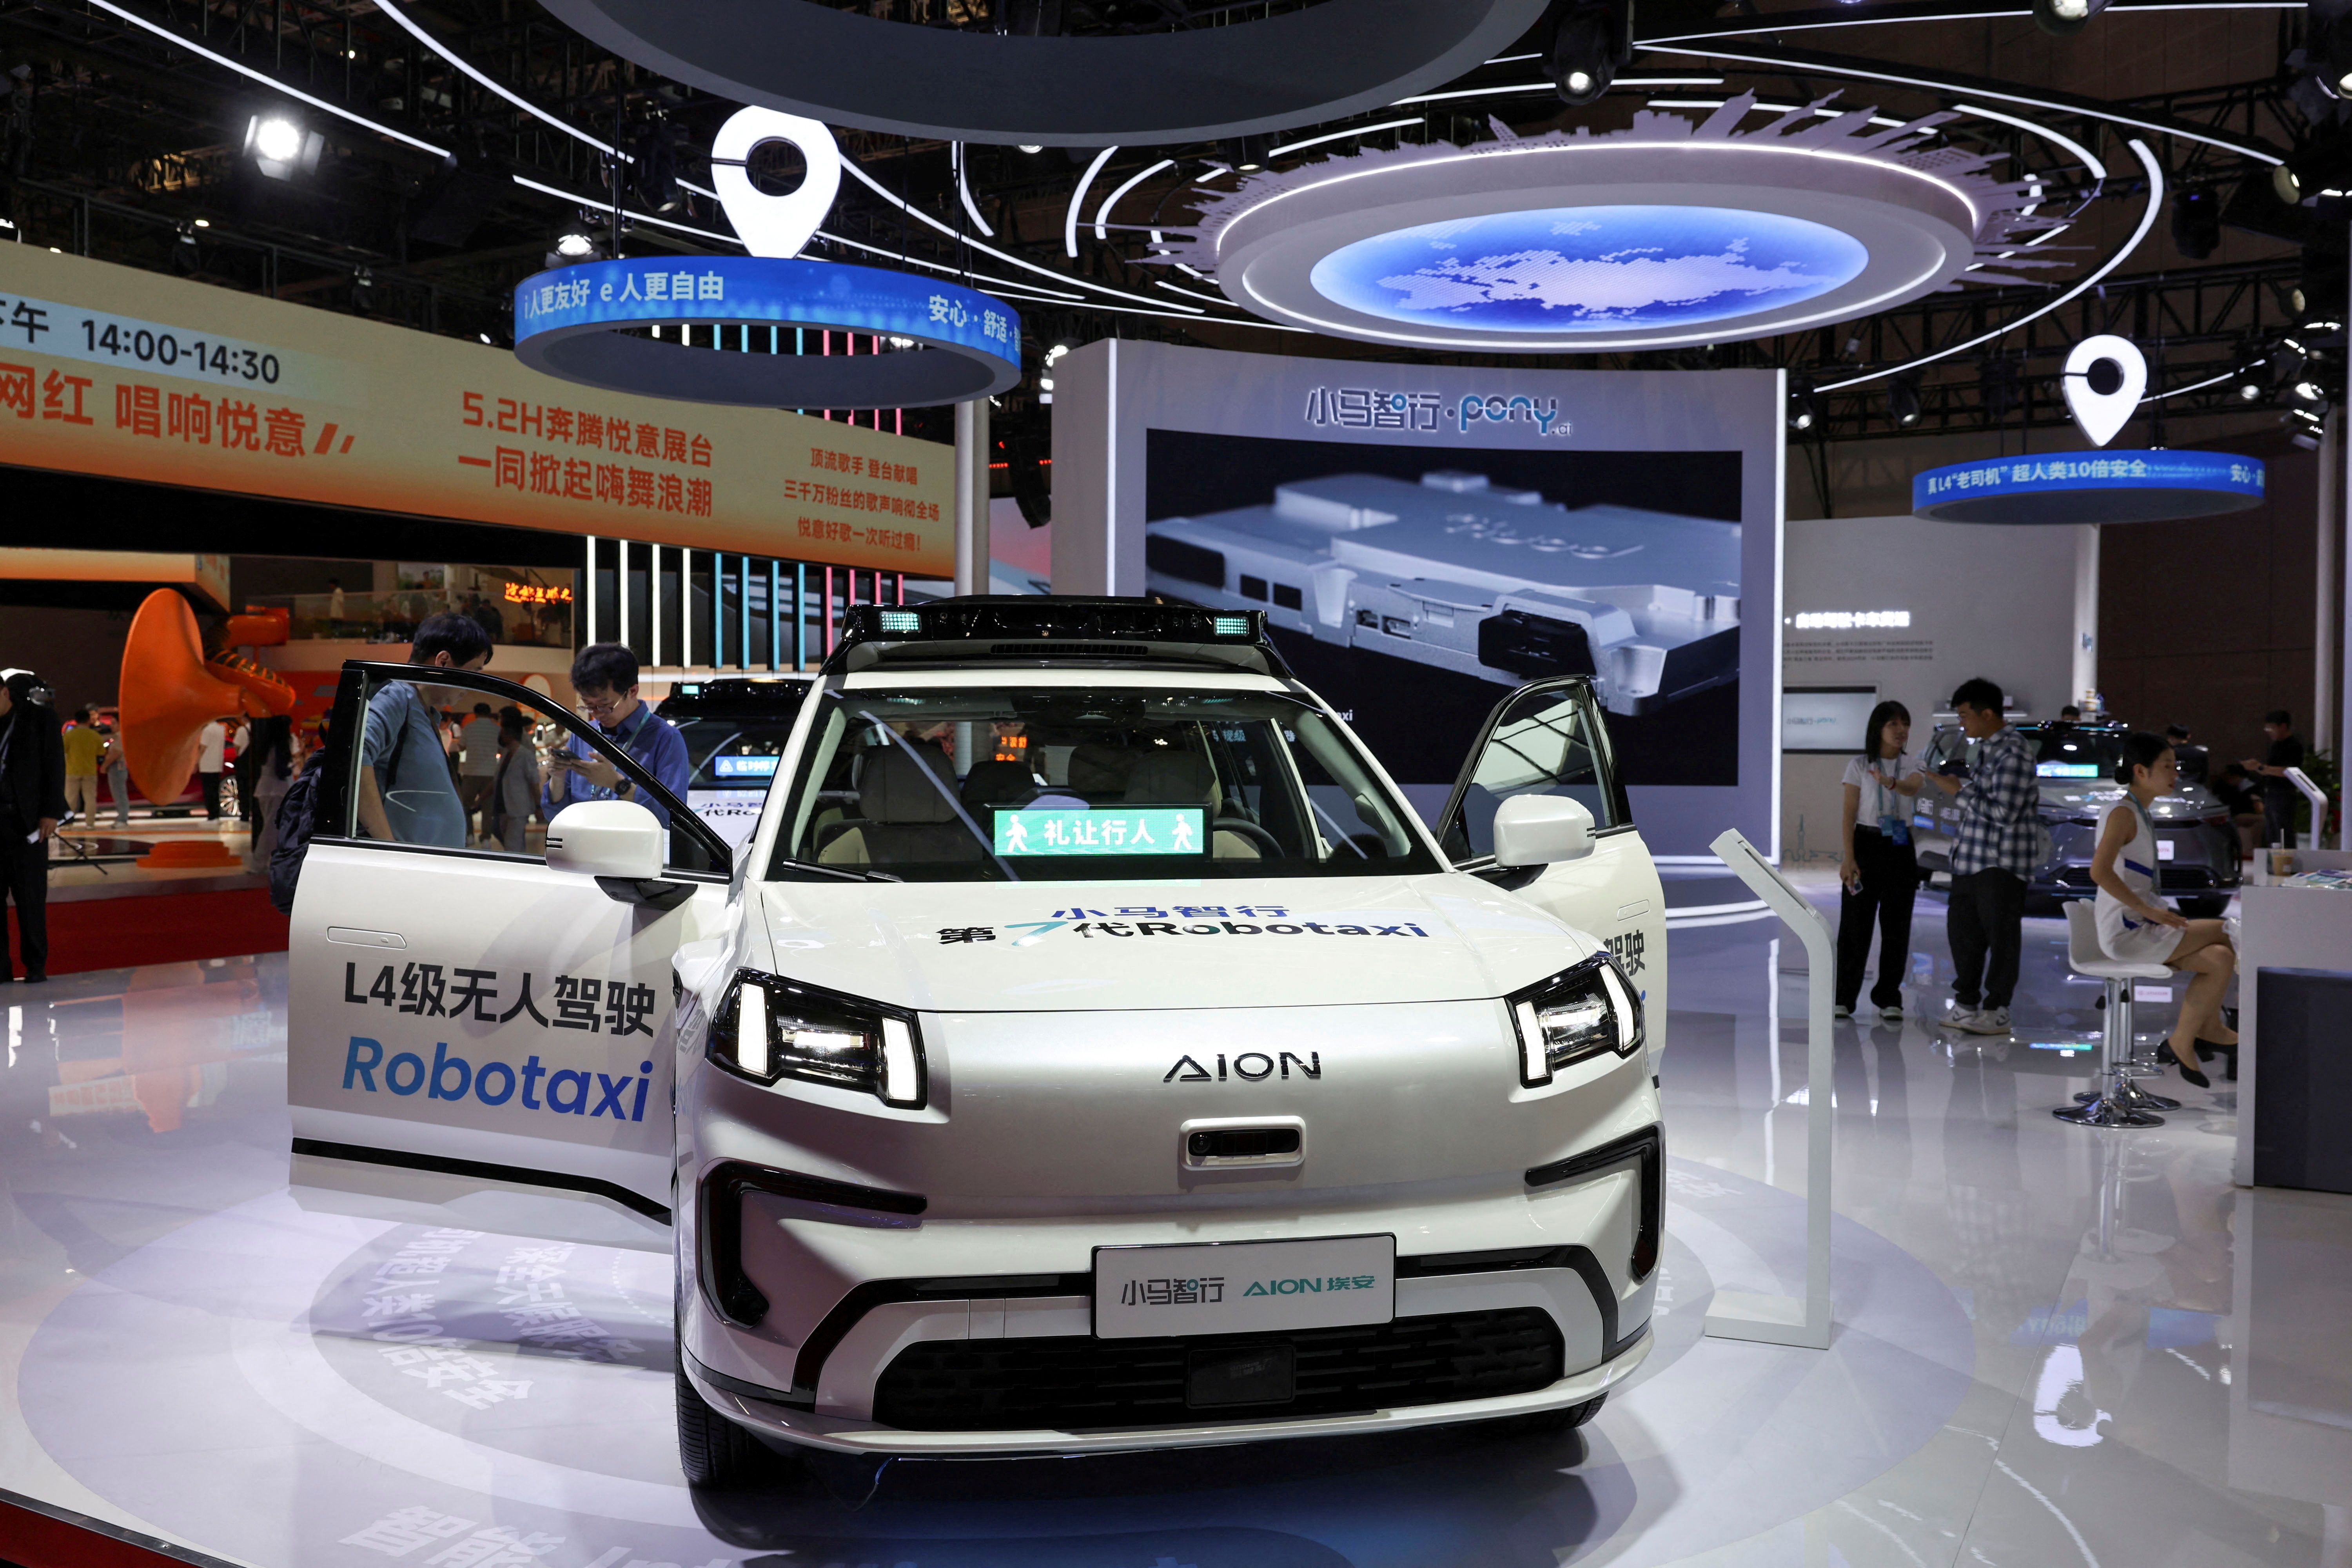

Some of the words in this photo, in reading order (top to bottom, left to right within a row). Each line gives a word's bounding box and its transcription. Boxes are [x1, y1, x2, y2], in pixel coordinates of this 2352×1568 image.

[82, 320, 280, 384] 14:00-14:30
[0, 362, 93, 426] 网红
[116, 384, 306, 457] 唱响悦意
[463, 391, 713, 468] 5.2H奔腾悦意展台
[458, 445, 712, 517] 一同掀起嗨舞浪潮
[811, 448, 864, 475] 顶流歌手
[868, 458, 918, 485] 登台献唱
[2011, 459, 2147, 483] 超人类10倍安全
[784, 479, 939, 522] 三千万粉丝的歌声响彻全场
[1044, 818, 1155, 846] 礼让行人
[1051, 906, 1290, 920] 小马智行
[936, 920, 1431, 947] 第7代Robotaxi
[345, 961, 655, 1038] L4级无人驾驶
[342, 1036, 653, 1123] Robotaxi
[1163, 1051, 1322, 1083] AION
[1121, 1276, 1225, 1307] 小马智行
[1243, 1278, 1321, 1297] AION
[1327, 1274, 1375, 1291] 埃安
